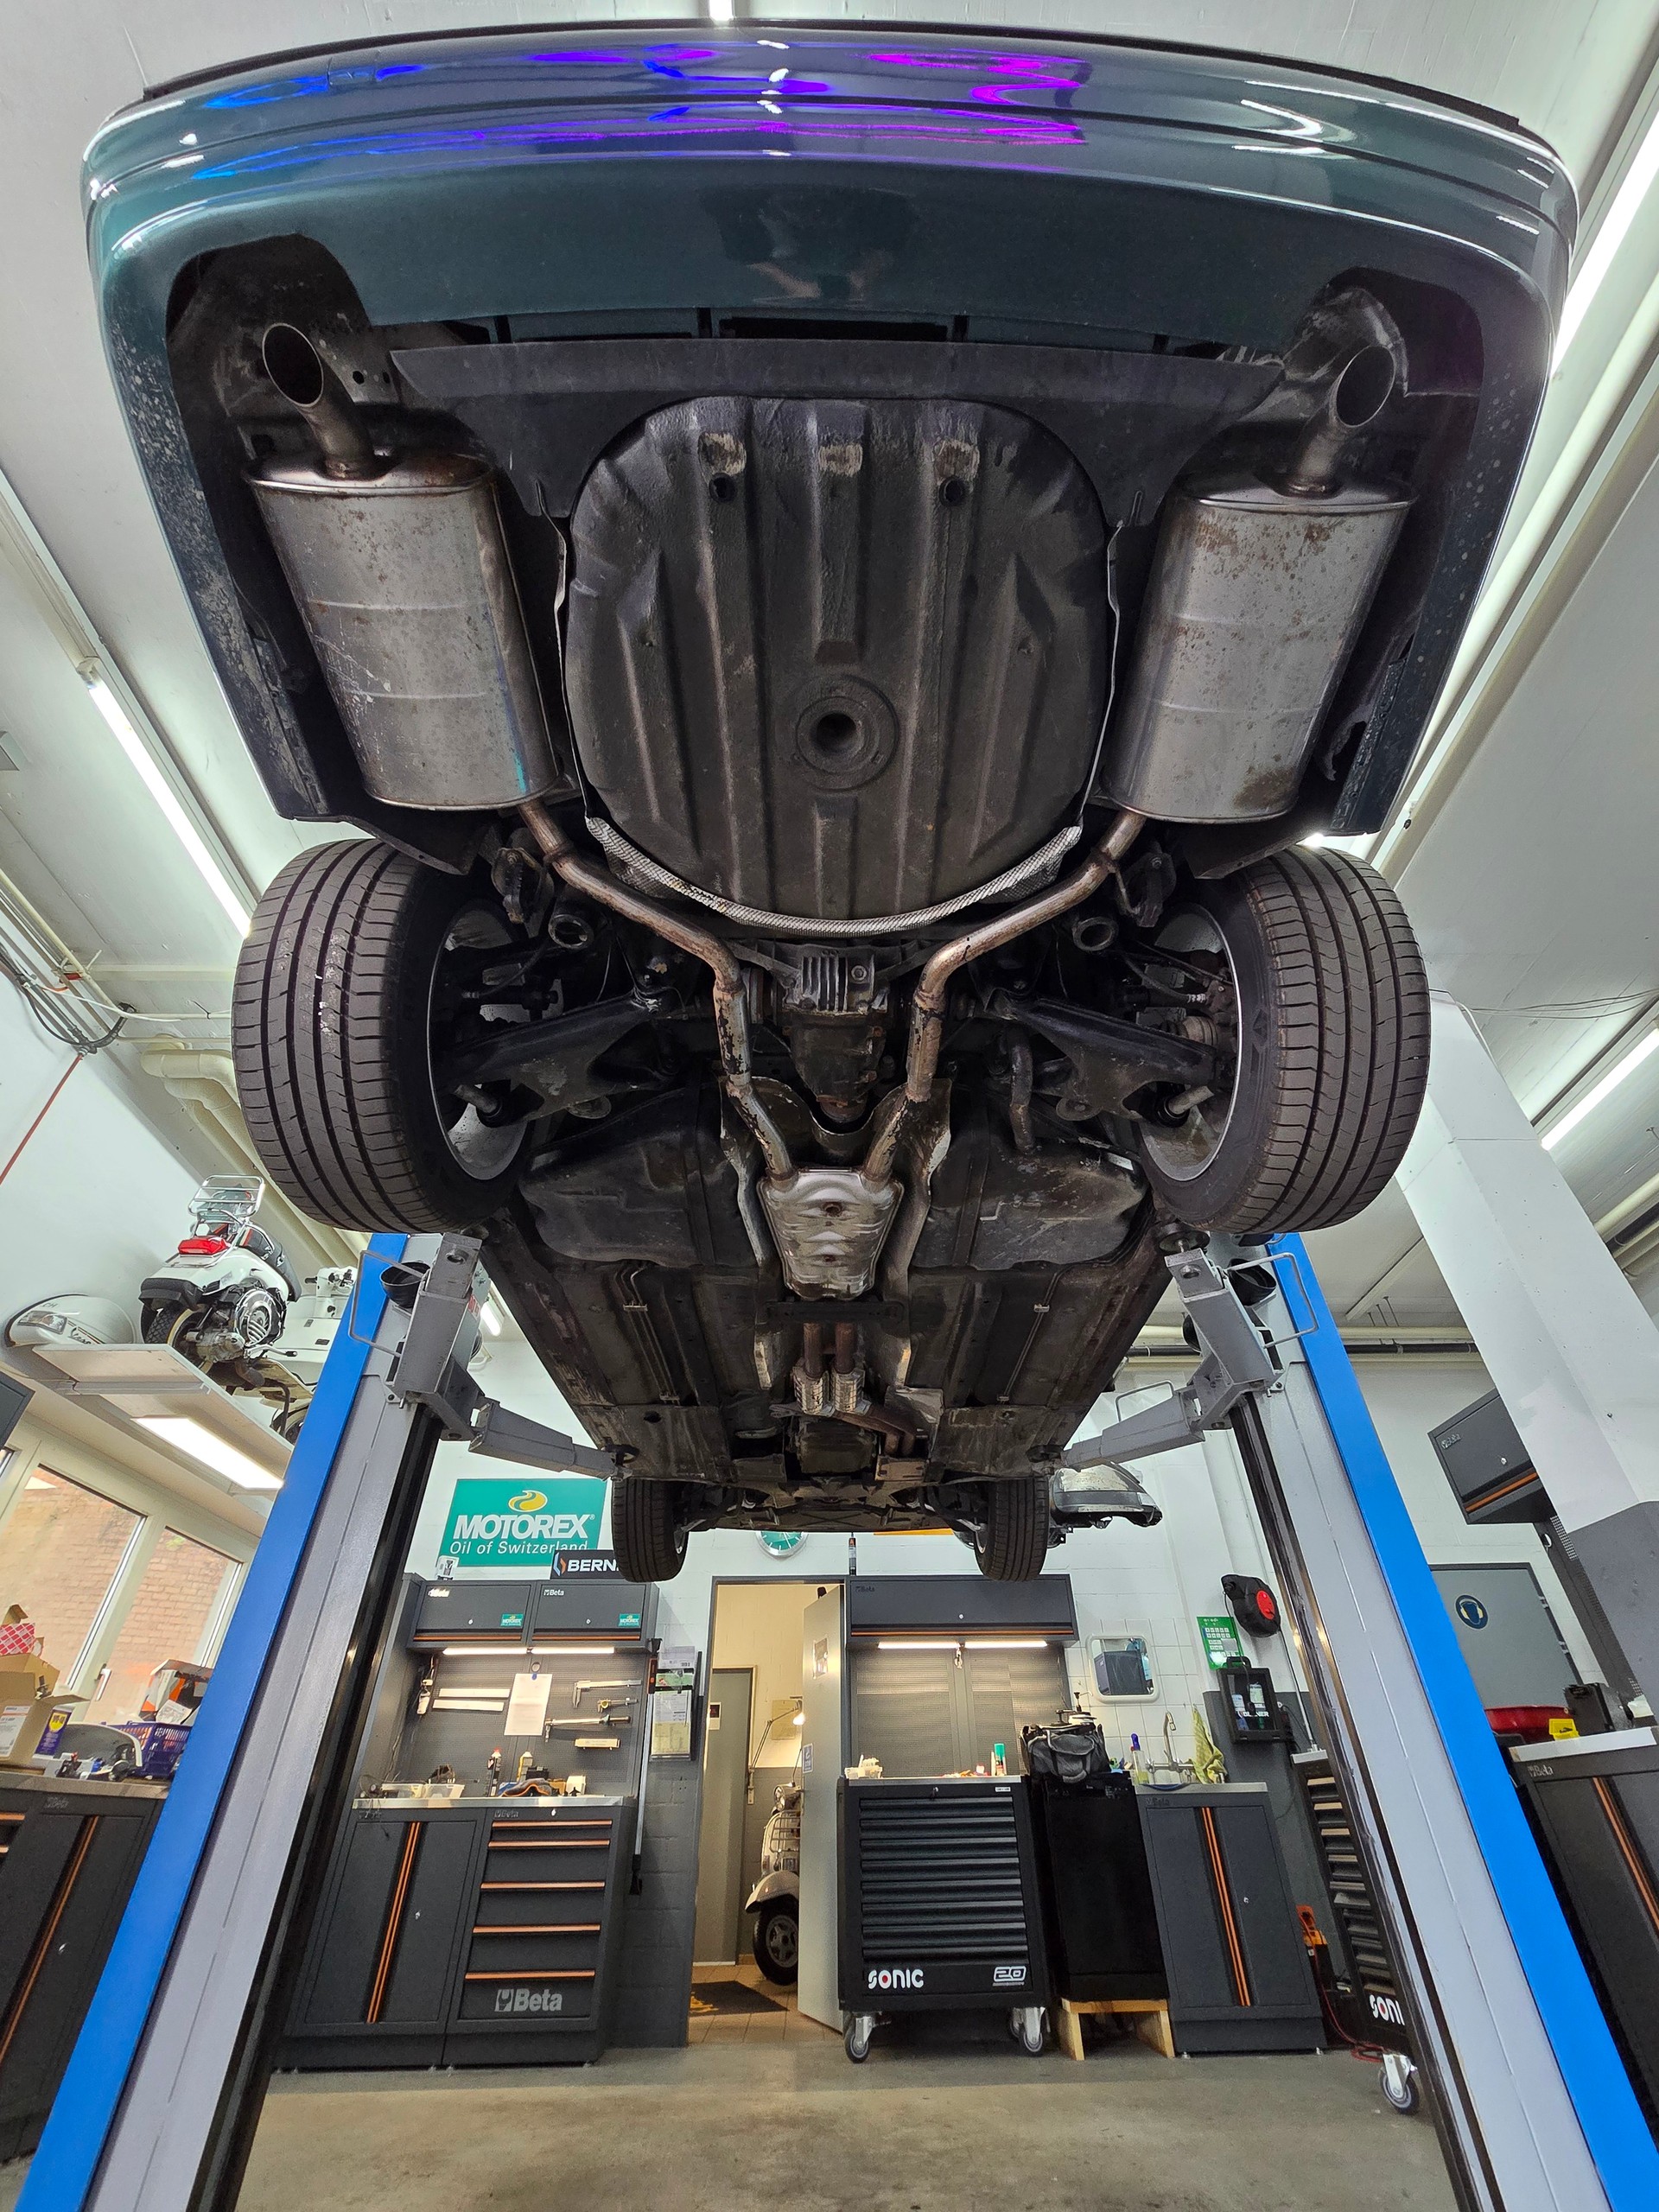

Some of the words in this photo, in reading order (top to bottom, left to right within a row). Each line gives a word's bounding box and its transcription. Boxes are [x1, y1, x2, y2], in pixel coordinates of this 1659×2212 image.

[449, 1541, 471, 1554] Oil
[476, 1541, 493, 1554] of
[497, 1541, 588, 1554] Switzerland
[567, 1559, 620, 1572] BERN
[1533, 1764, 1554, 1777] Beta
[868, 1969, 924, 1989] SONIC
[513, 1988, 563, 2012] Beta
[1369, 1994, 1405, 2026] SONI
